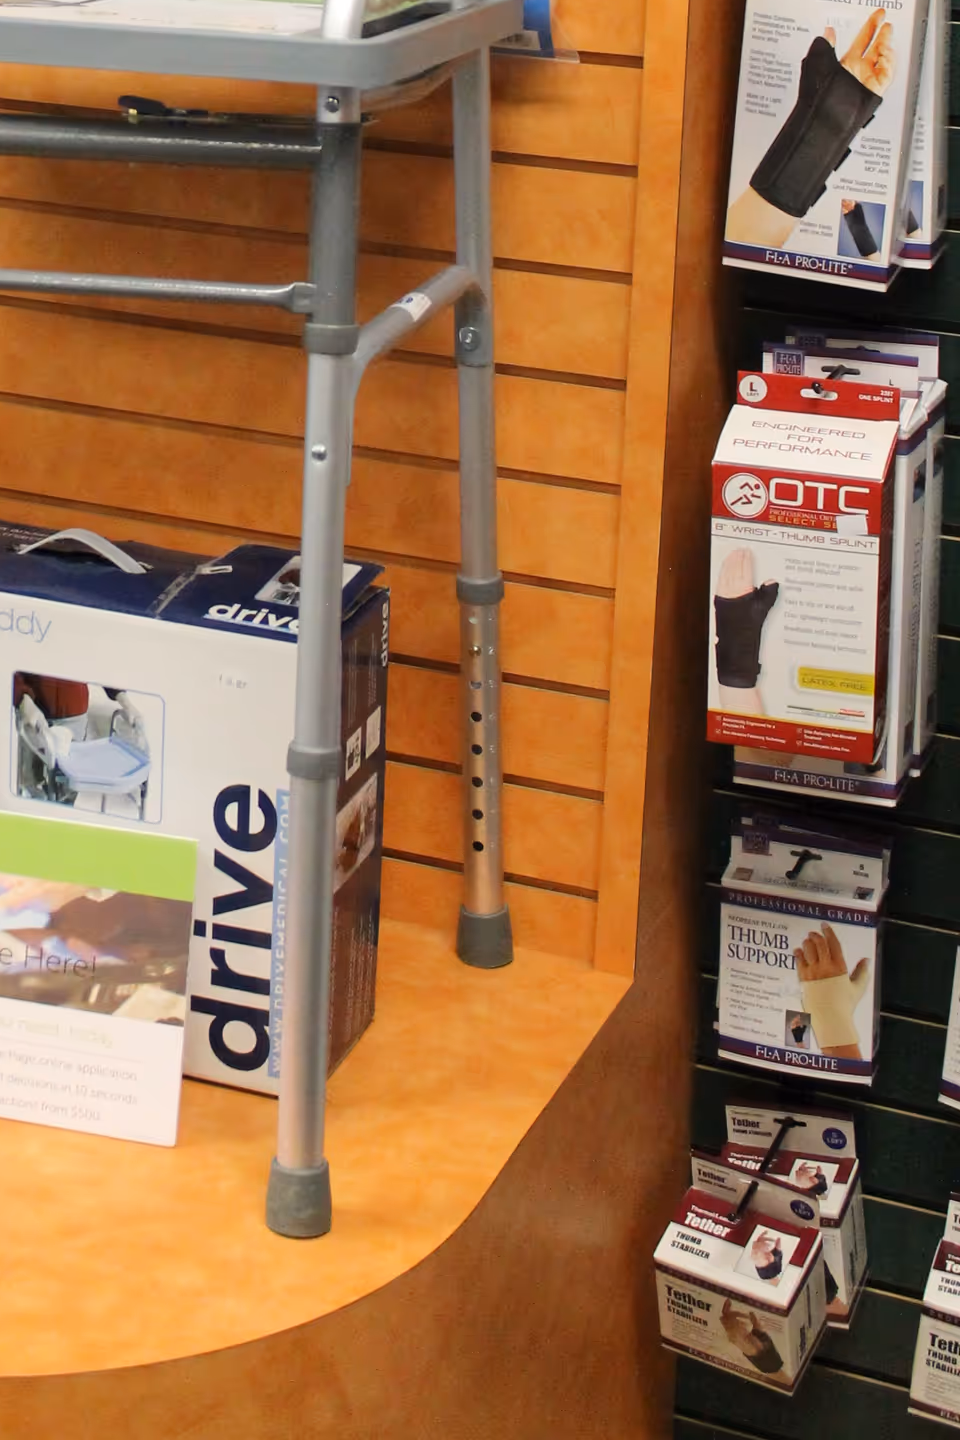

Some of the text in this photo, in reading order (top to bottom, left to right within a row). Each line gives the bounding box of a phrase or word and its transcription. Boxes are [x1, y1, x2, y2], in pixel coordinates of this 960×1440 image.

[750, 382, 757, 392] L
[751, 420, 866, 439] ENGINEERED
[787, 434, 823, 445] FOR
[732, 438, 872, 461] PERFORMANCE
[769, 477, 870, 515] OTC
[769, 508, 818, 520] PROFESSIONAL
[769, 514, 816, 527] SELECT
[731, 525, 770, 537] WRIST
[780, 531, 825, 544] THUMB
[829, 537, 876, 549] SPLINT
[802, 678, 867, 691] LATEX FREE
[728, 893, 870, 923] PROFESSIONAL GRADE
[190, 783, 278, 1073] drive
[728, 915, 760, 926] NEOPRENE
[727, 924, 789, 950] THUMB
[25, 944, 97, 979] Here!
[727, 943, 796, 970] SUPPORT
[77, 1062, 137, 1081] application
[6, 1073, 57, 1091] decisions
[89, 1089, 138, 1105] seconds
[41, 1102, 68, 1117] from
[731, 1117, 760, 1128] Tether
[697, 1168, 726, 1183] Tether
[685, 1212, 731, 1237] Tether
[676, 1231, 702, 1246] THUMB
[670, 1241, 710, 1259] STABILIZER
[665, 1284, 712, 1312] Tether
[667, 1306, 708, 1326] STABILIZER
[927, 1349, 958, 1365] THUMB
